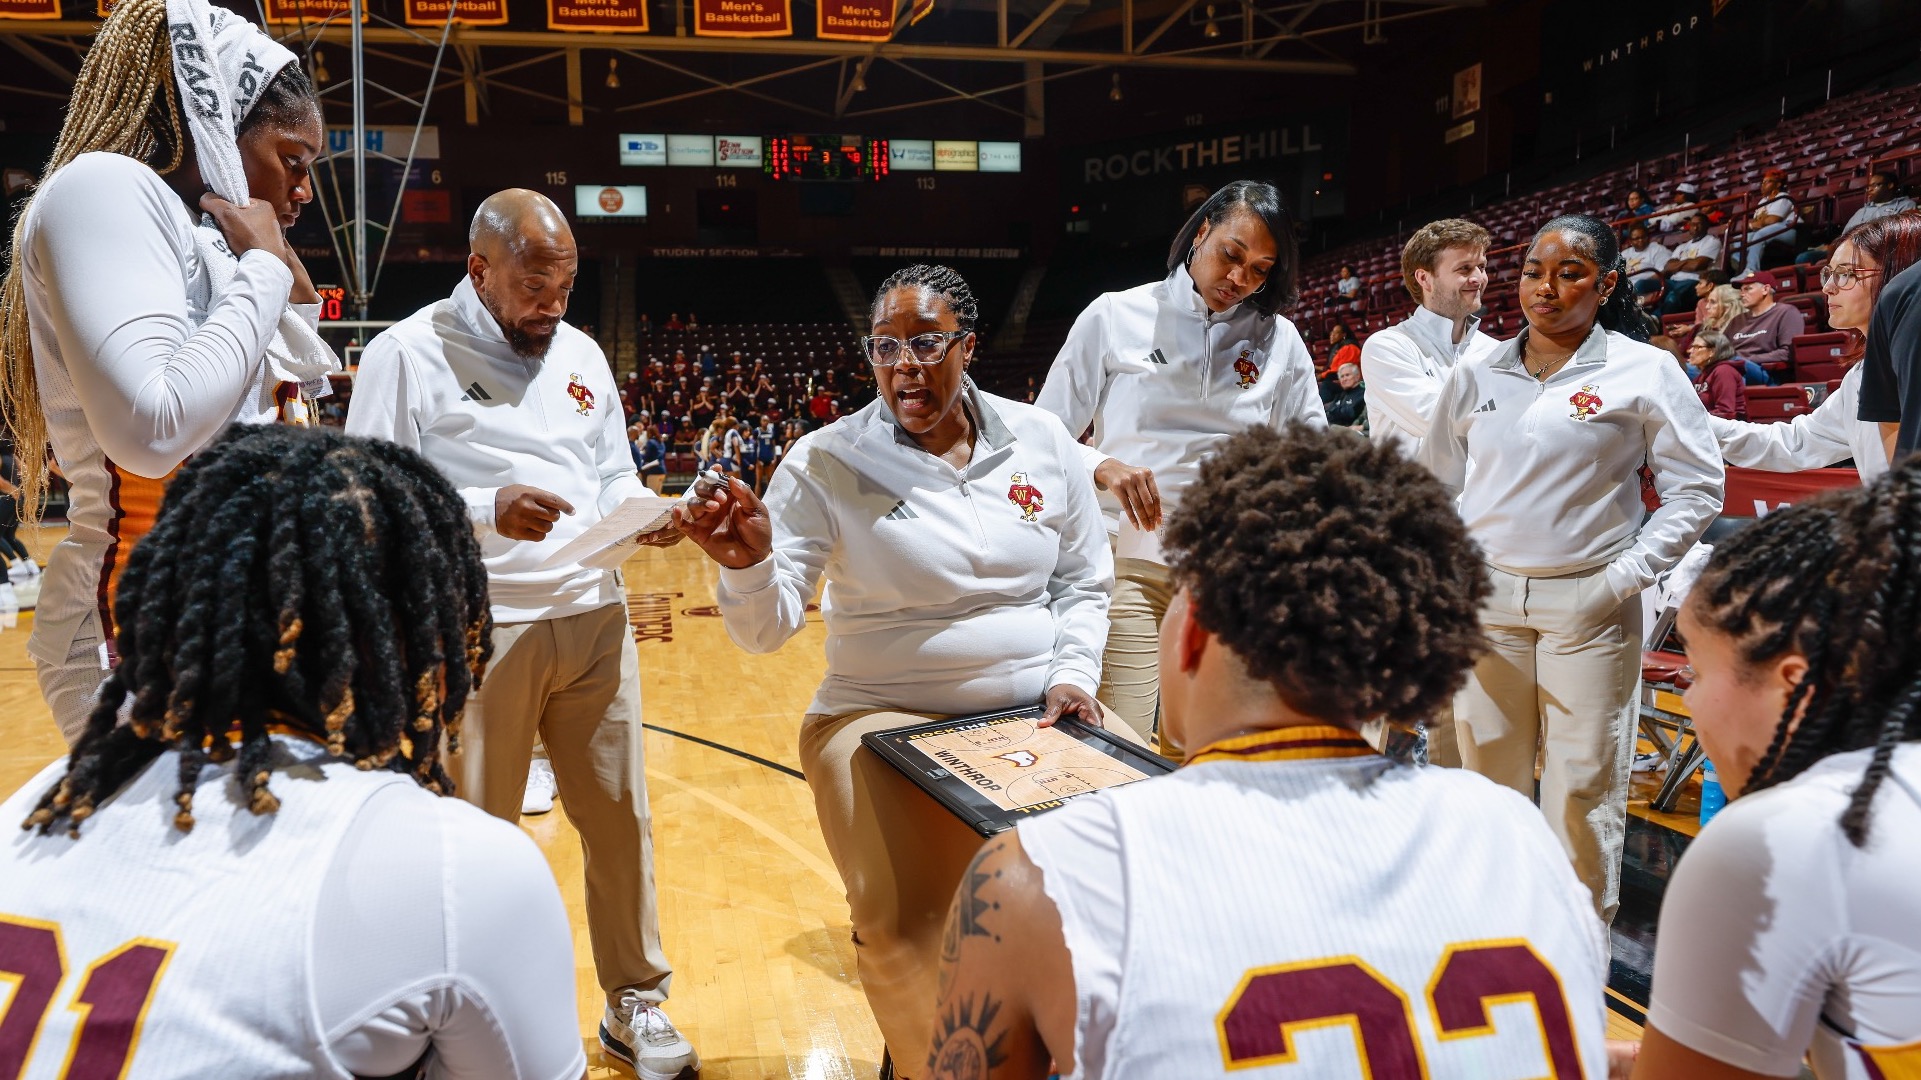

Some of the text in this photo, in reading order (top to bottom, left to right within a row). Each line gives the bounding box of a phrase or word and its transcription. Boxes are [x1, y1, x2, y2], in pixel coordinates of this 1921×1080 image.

[559, 7, 637, 17] Basketball
[721, 1, 763, 12] Men's
[842, 6, 881, 17] Men's
[705, 13, 780, 23] Basketball
[1583, 15, 1698, 72] WINTHROP
[822, 151, 830, 164] 3
[431, 169, 442, 184] 6
[545, 171, 567, 185] 115
[716, 174, 736, 188] 114
[917, 176, 936, 190] 113
[653, 247, 758, 257] STUDENT SECTION
[571, 386, 582, 397] W
[1577, 395, 1590, 405] W
[1014, 489, 1028, 500] W
[934, 749, 1003, 792] WINTHROP
